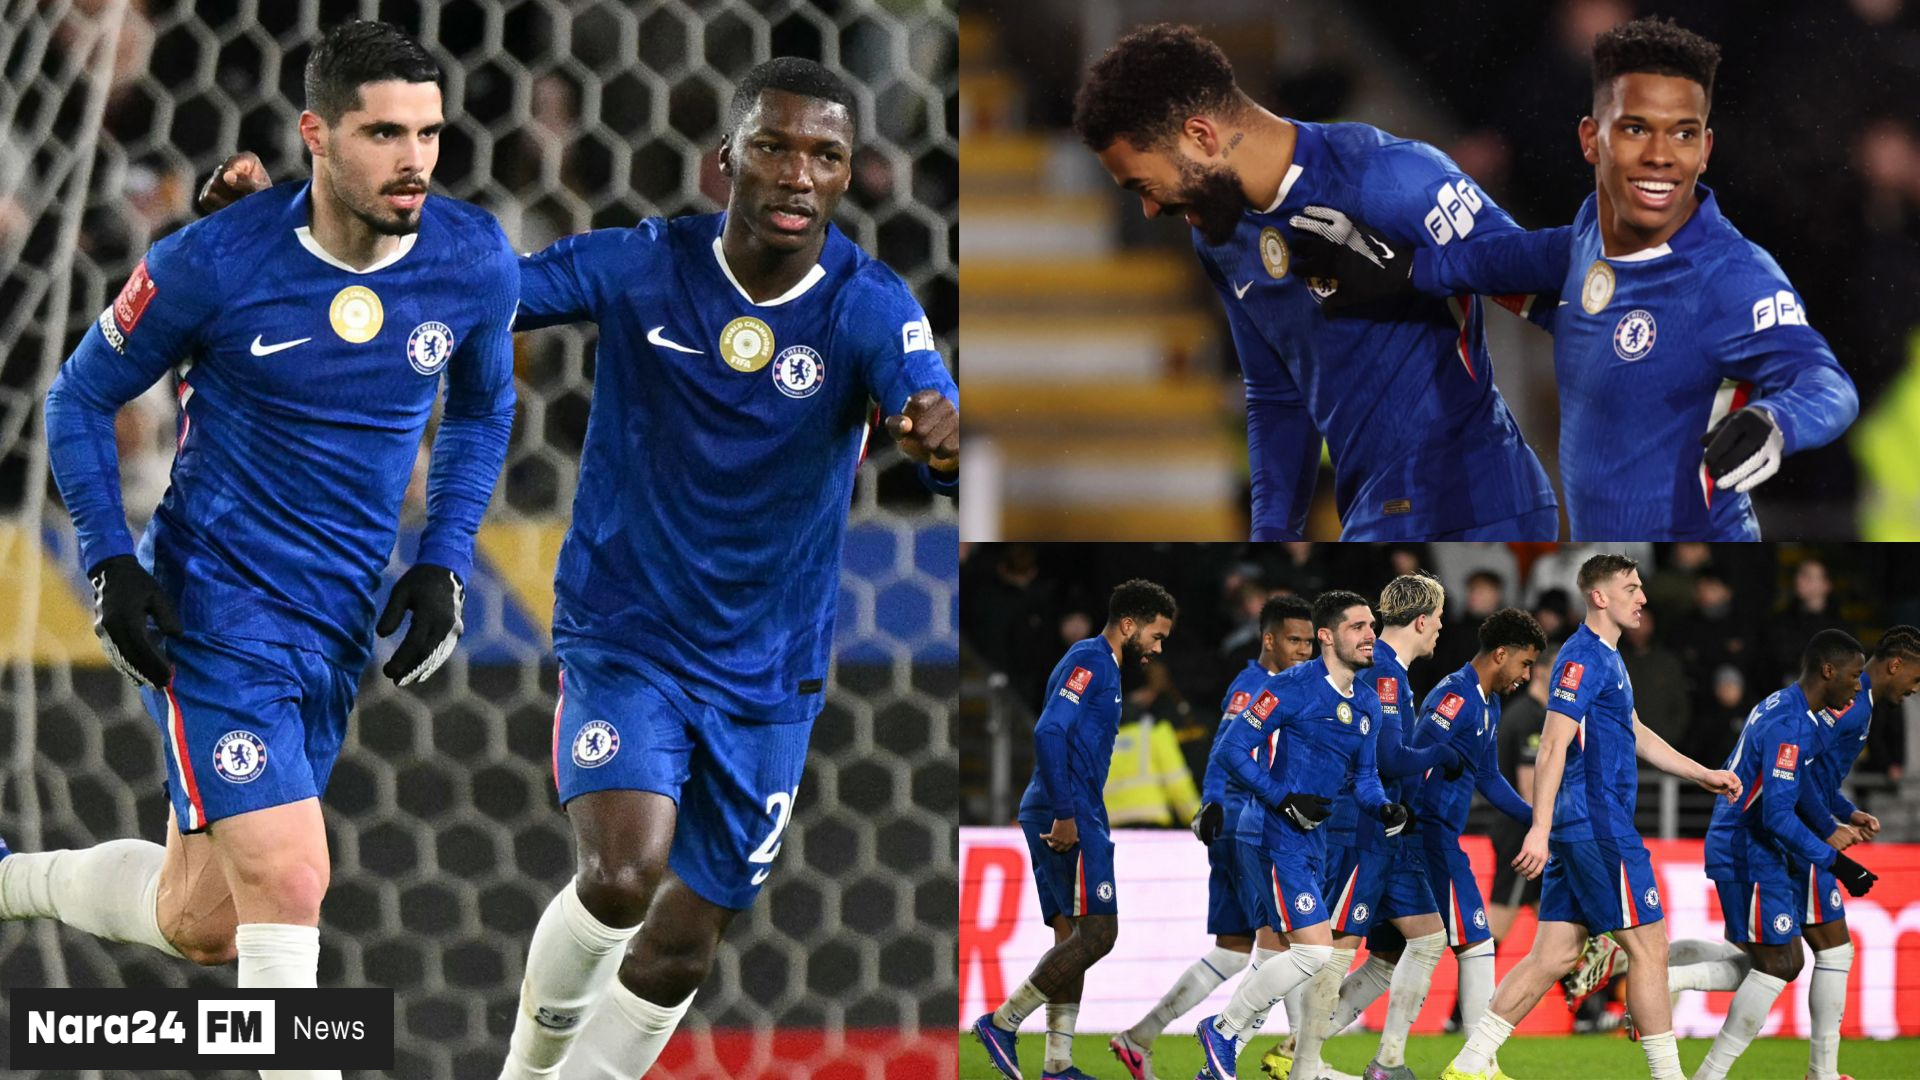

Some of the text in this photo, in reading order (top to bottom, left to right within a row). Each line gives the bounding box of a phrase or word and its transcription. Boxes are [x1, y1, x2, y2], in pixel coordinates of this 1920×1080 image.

[1430, 187, 1474, 239] FPT
[417, 323, 448, 335] CHELSEA
[724, 321, 770, 356] WORLD CHAMPIONS
[782, 347, 816, 359] CHELSEA
[730, 355, 751, 369] FIFA
[220, 733, 253, 747] CHELSEA
[748, 785, 799, 864] 2
